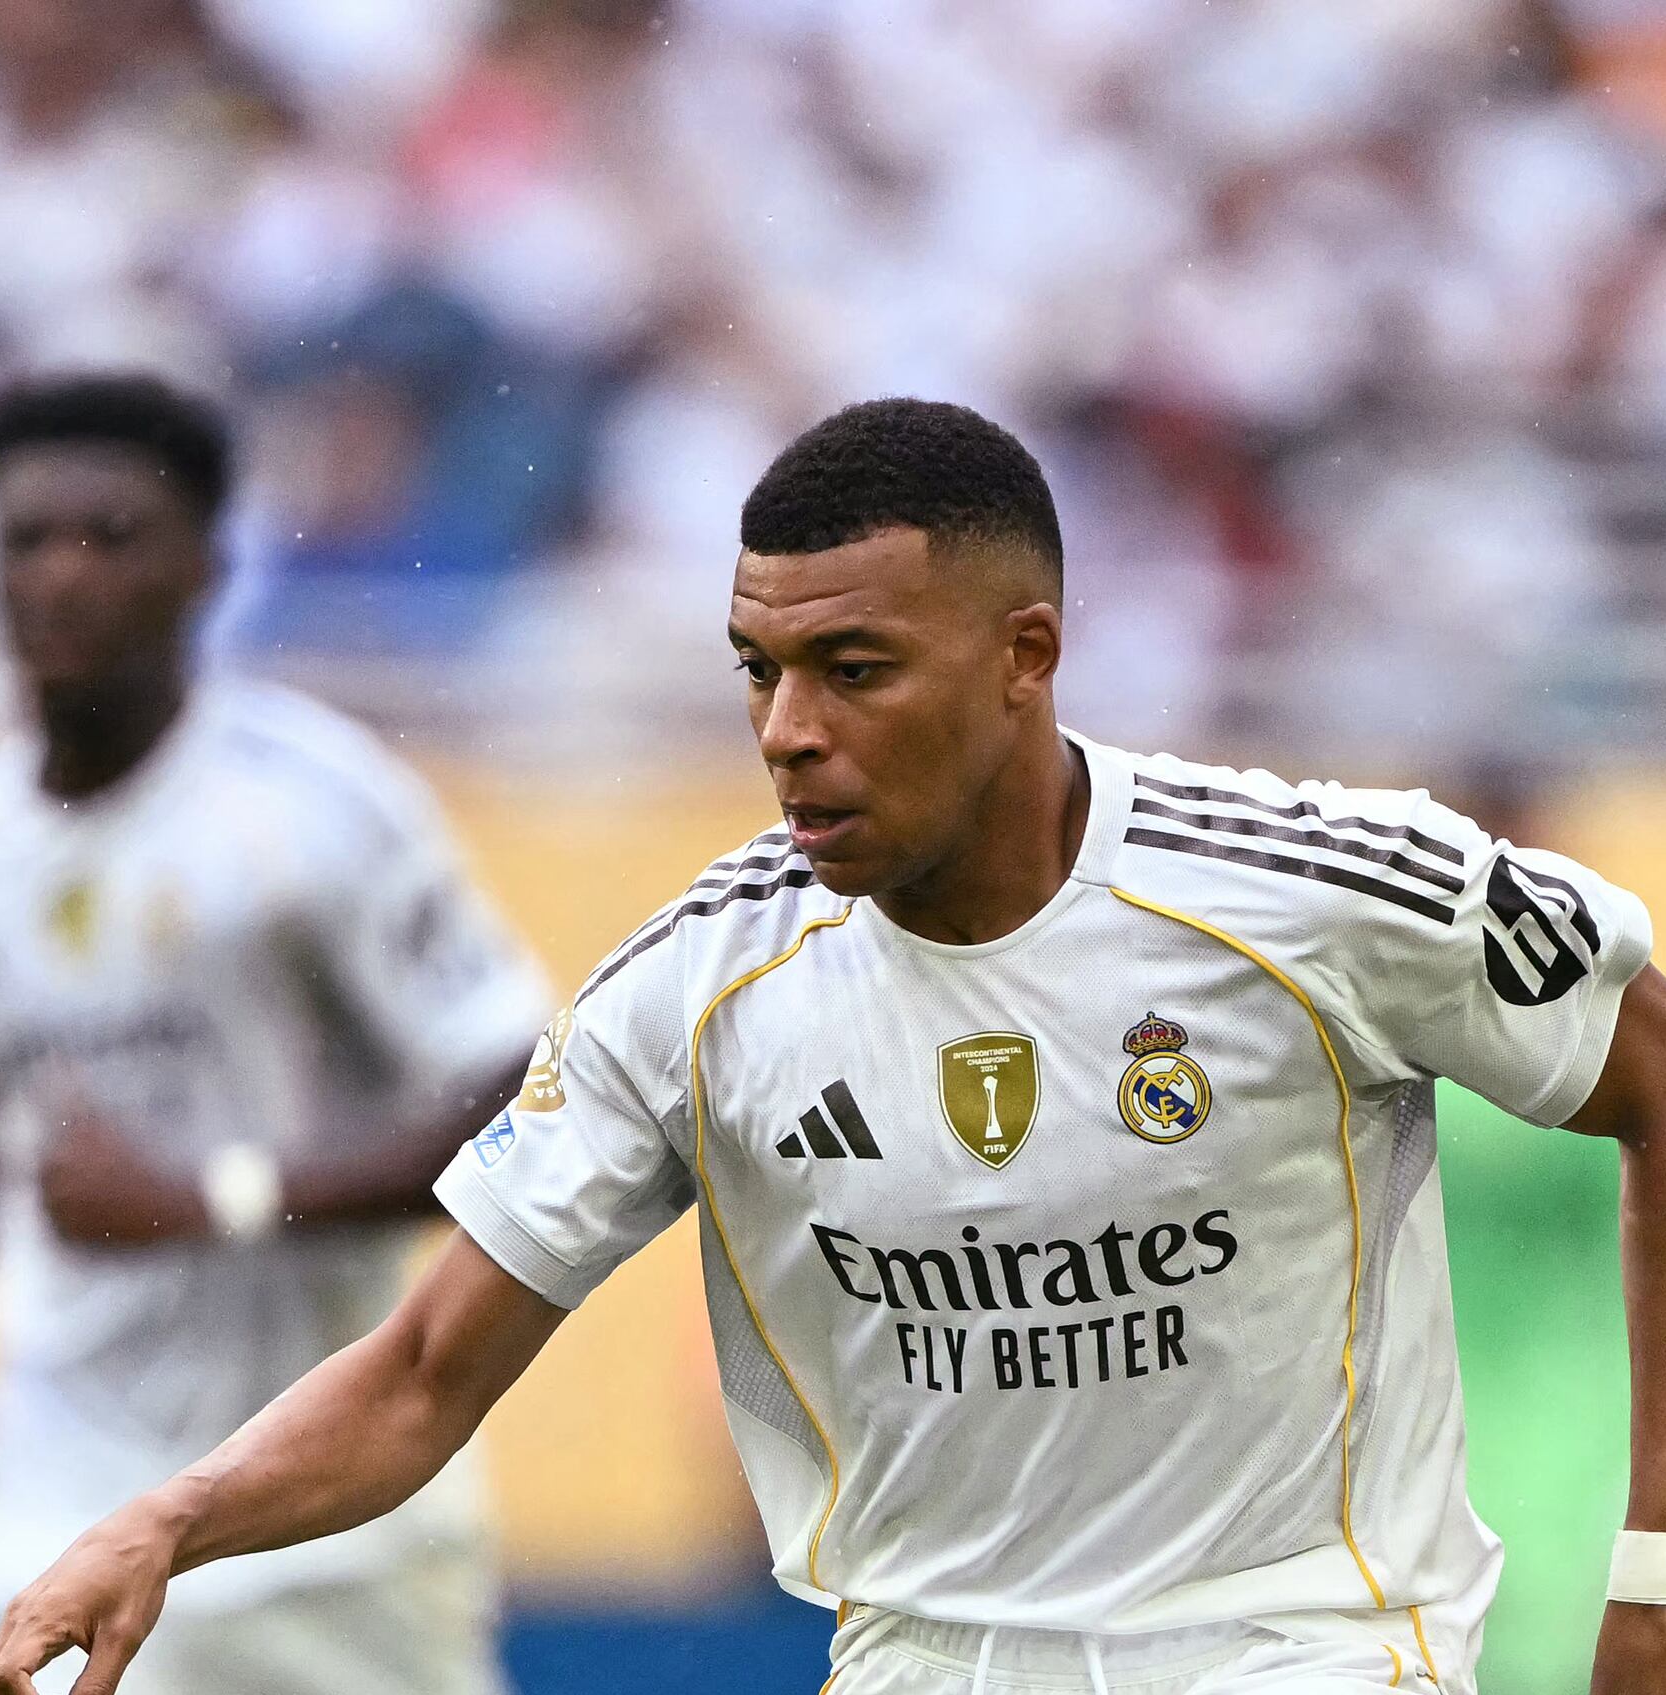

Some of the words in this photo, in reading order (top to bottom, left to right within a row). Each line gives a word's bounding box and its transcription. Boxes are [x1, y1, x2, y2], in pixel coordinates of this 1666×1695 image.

[952, 1046, 1023, 1060] INTERCONTINENTAL
[966, 1055, 1011, 1067] CHAMPIONS
[979, 1065, 999, 1073] 2024
[983, 1144, 1008, 1155] FIFA
[809, 1209, 1238, 1311] Emirates
[896, 1322, 968, 1394] FLY
[991, 1304, 1189, 1391] BETTER
